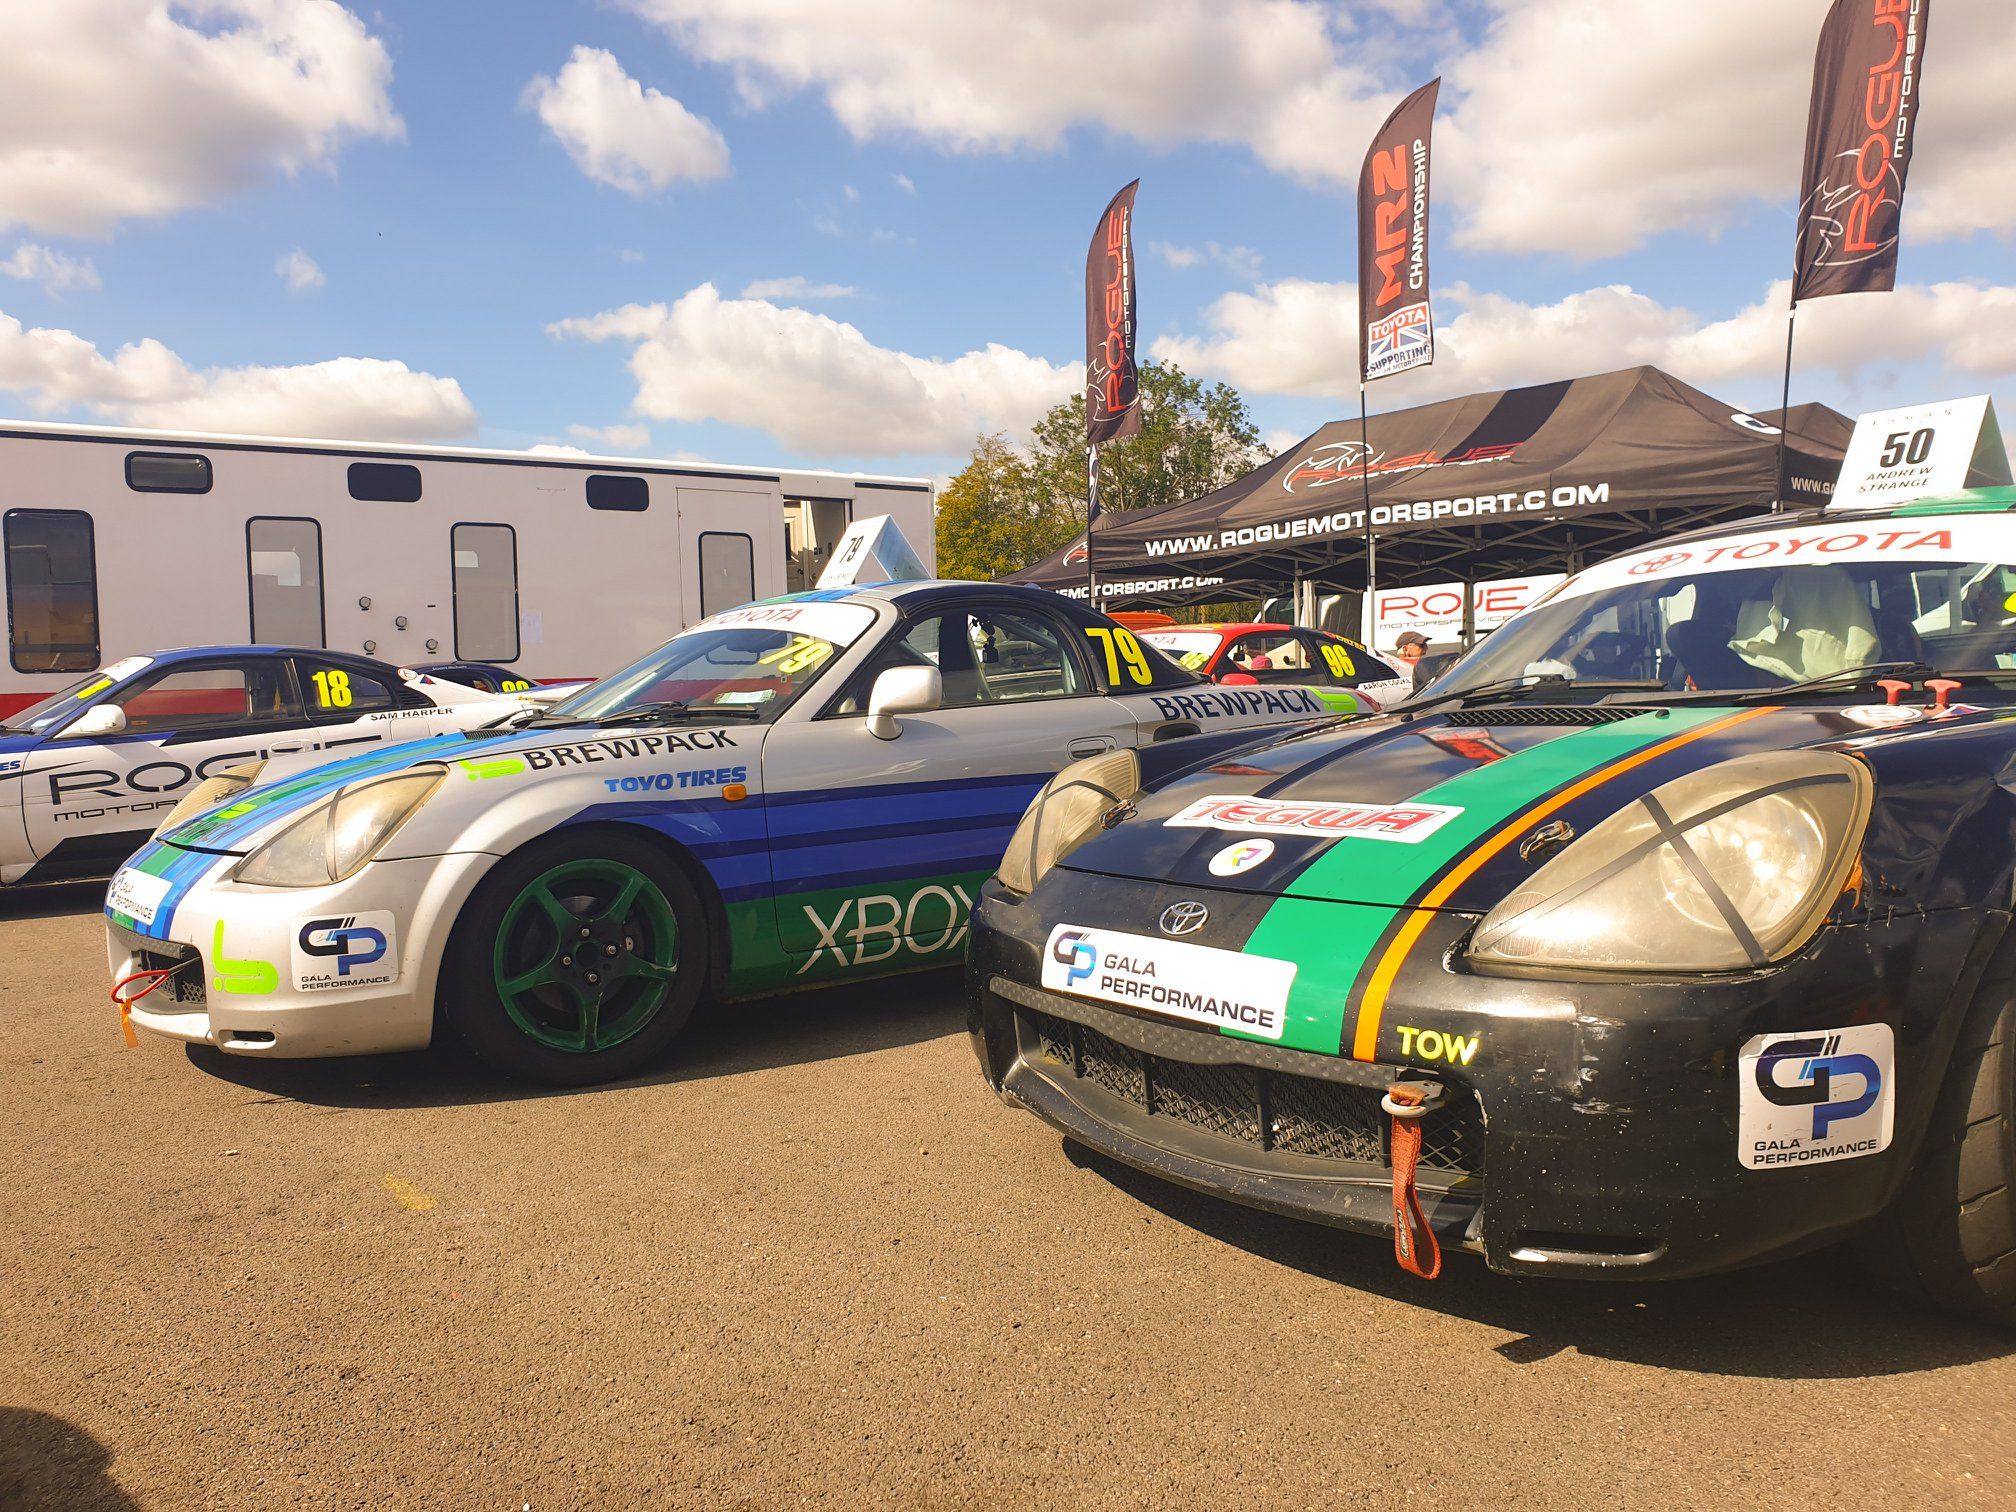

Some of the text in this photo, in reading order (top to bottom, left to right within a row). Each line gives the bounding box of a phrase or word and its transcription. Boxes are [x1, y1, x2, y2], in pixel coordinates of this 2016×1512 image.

[1893, 0, 1920, 158] MOTORSPO
[1844, 0, 1909, 251] ROGUE
[1372, 144, 1408, 307] MR2
[1409, 138, 1427, 290] CHAMPIONSHIP
[1106, 206, 1126, 413] ROGUE
[1372, 308, 1426, 340] TOYOTA
[1369, 344, 1431, 372] SUPPORTING
[1880, 428, 1936, 468] 50
[1791, 476, 1837, 495] WWW.GA
[1858, 477, 1930, 493] STRANGE
[1866, 466, 1934, 481] ANDREW
[839, 535, 864, 563] 79
[1704, 530, 1951, 564] TOYOTA
[759, 636, 834, 674] 79
[1085, 627, 1152, 686] 79
[1321, 643, 1356, 678] 96
[312, 670, 353, 708] 18
[1150, 689, 1320, 721] BREWPACK
[371, 707, 454, 721] SAM HARPER
[523, 730, 738, 771] BREWPACK
[604, 766, 747, 793] TOYO TIRES
[1197, 802, 1438, 831] TEGIWA
[301, 974, 332, 983] GALA
[1104, 953, 1156, 978] GALA
[301, 975, 391, 990] PERFORMANCE
[1101, 974, 1275, 1029] PERFORMANCE
[1396, 1025, 1480, 1066] TOW
[1753, 1138, 1878, 1165] PERFORMANCE
[1754, 1138, 1801, 1151] GALA
